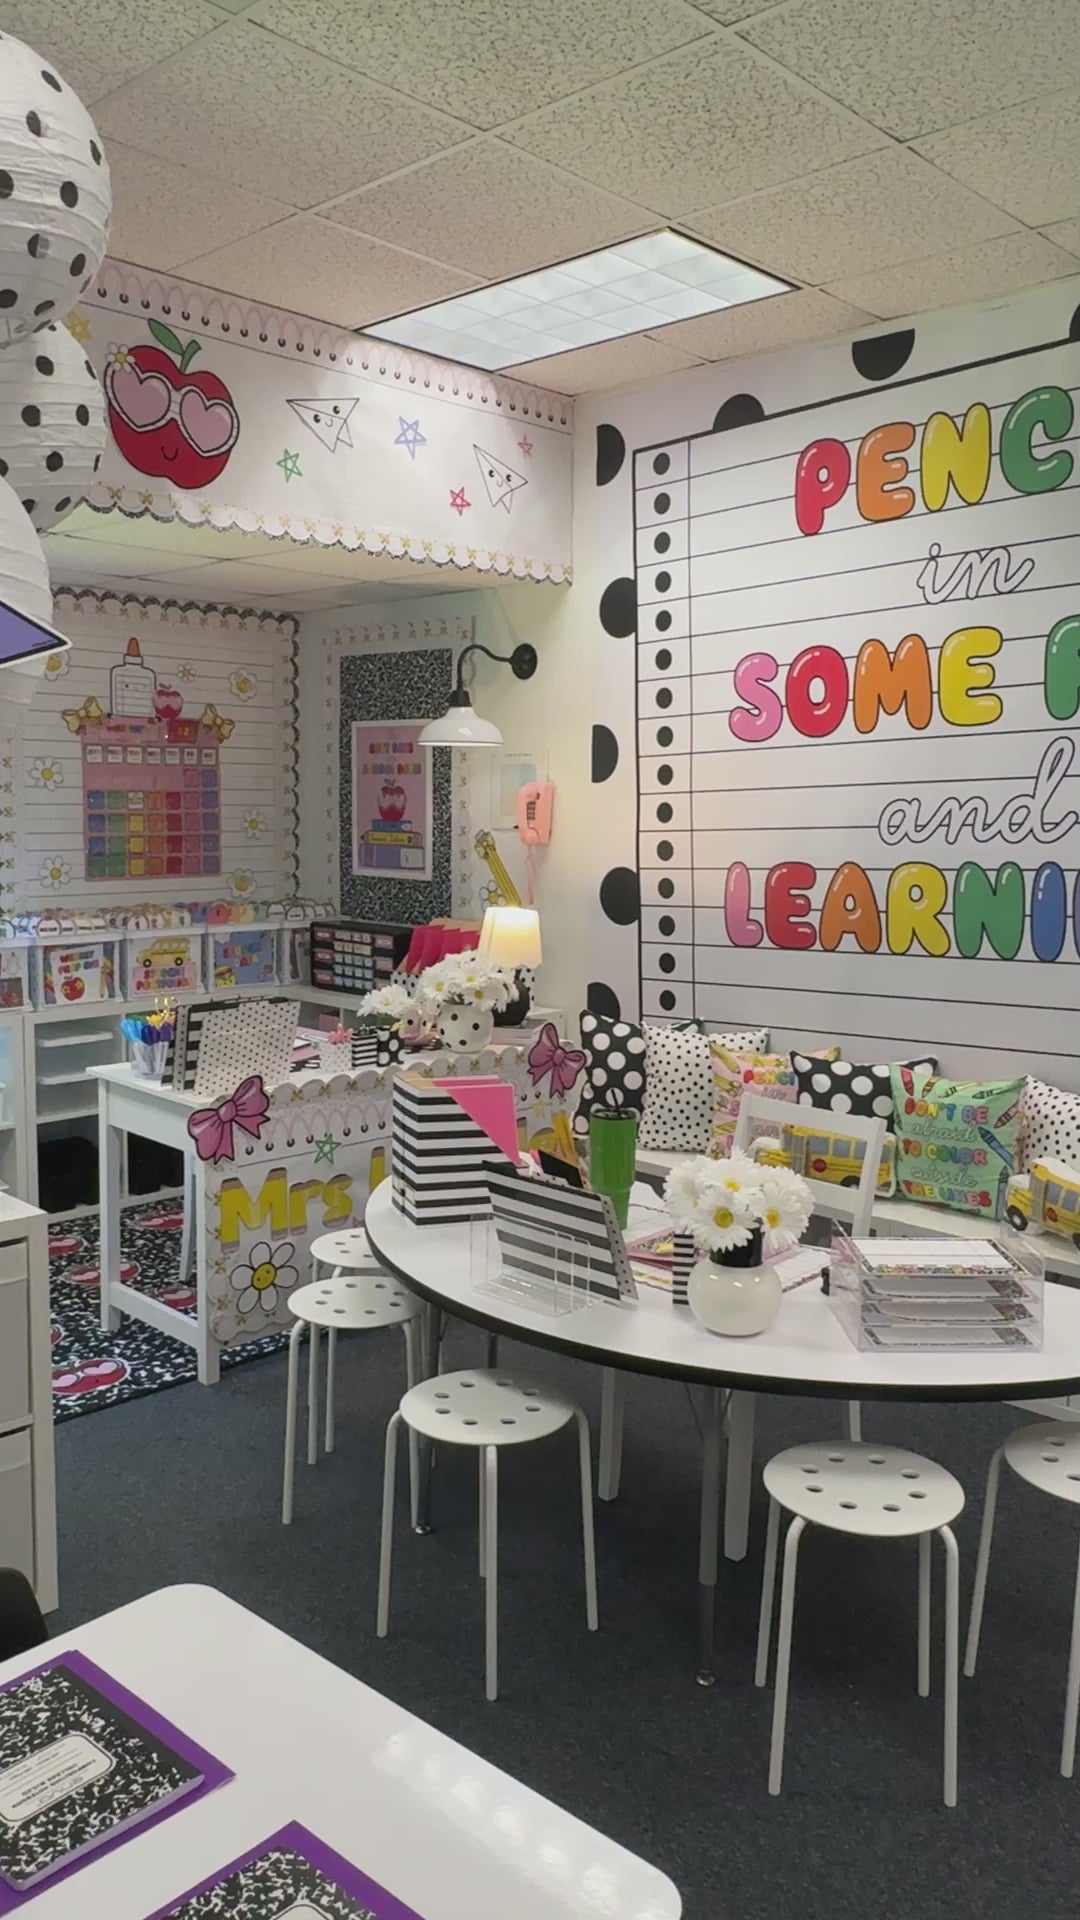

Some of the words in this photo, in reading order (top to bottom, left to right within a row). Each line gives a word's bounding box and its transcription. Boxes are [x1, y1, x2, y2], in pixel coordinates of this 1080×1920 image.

[795, 386, 1075, 536] PENC
[917, 543, 1035, 604] in
[729, 626, 1003, 742] SOME
[878, 736, 1079, 845] and
[724, 861, 1080, 962] LEARNI
[743, 1069, 797, 1086] PENCI
[904, 1097, 957, 1122] DON'T
[961, 1105, 990, 1125] BE
[902, 1138, 922, 1158] TO
[926, 1143, 989, 1166] COLOR
[220, 1167, 353, 1254] Mrs
[902, 1180, 935, 1198] THE
[938, 1186, 993, 1208] LINES
